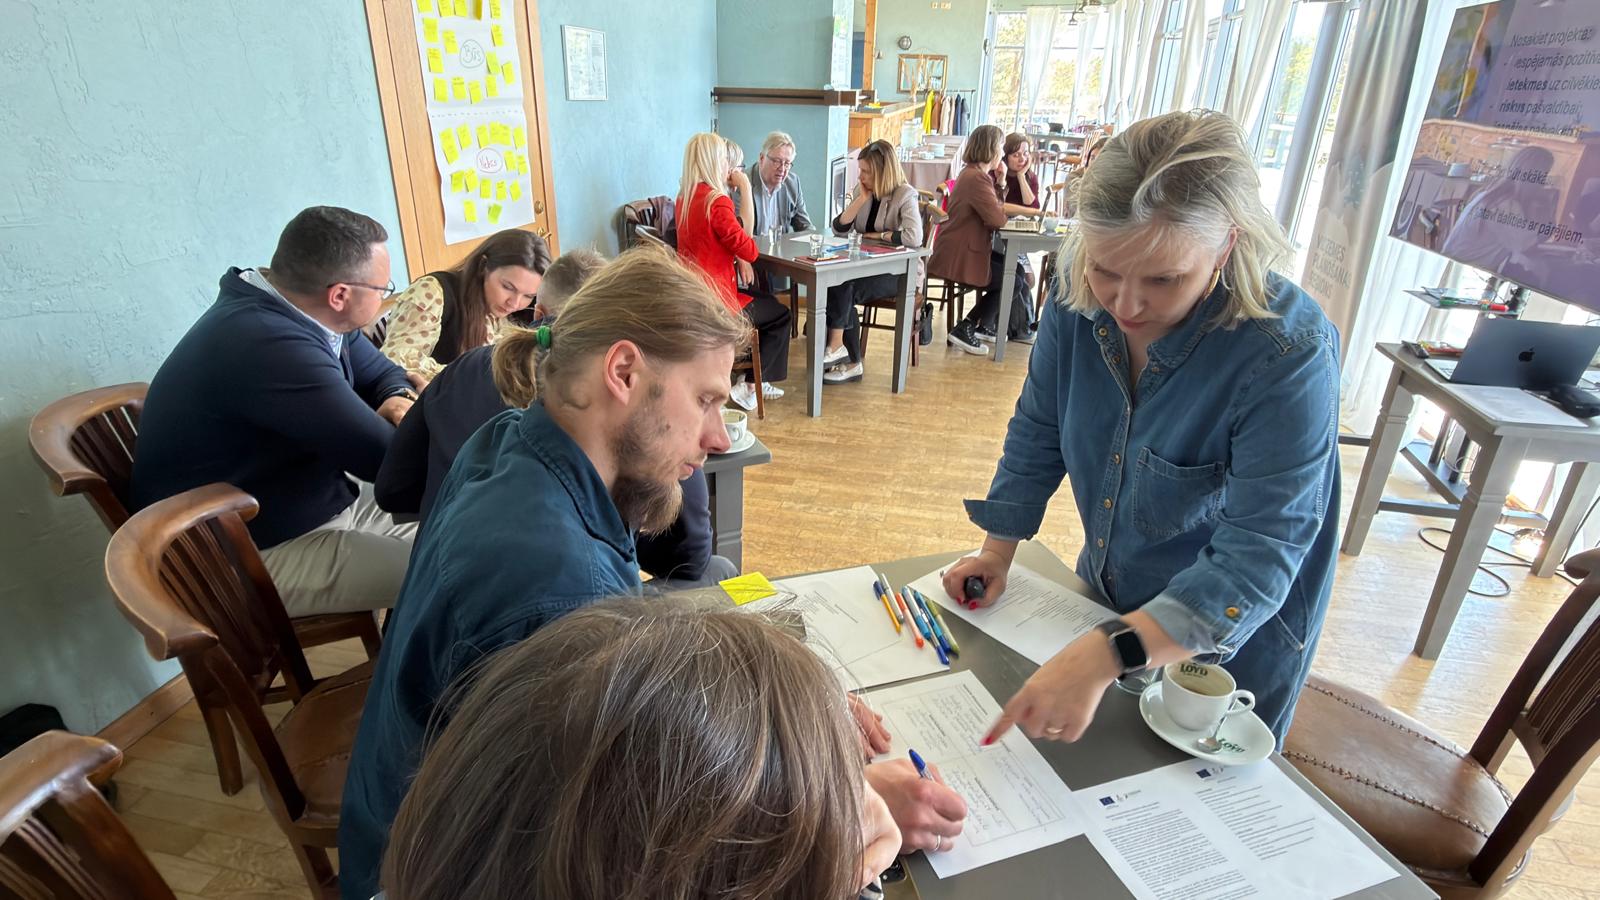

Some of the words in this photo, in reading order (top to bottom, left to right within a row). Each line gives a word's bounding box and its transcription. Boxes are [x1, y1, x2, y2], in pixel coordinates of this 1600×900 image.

[1548, 80, 1561, 91] uz
[1561, 75, 1600, 91] cilvēkie
[1499, 100, 1525, 113] riskus
[1527, 220, 1539, 232] ar
[1179, 663, 1208, 676] LOYD
